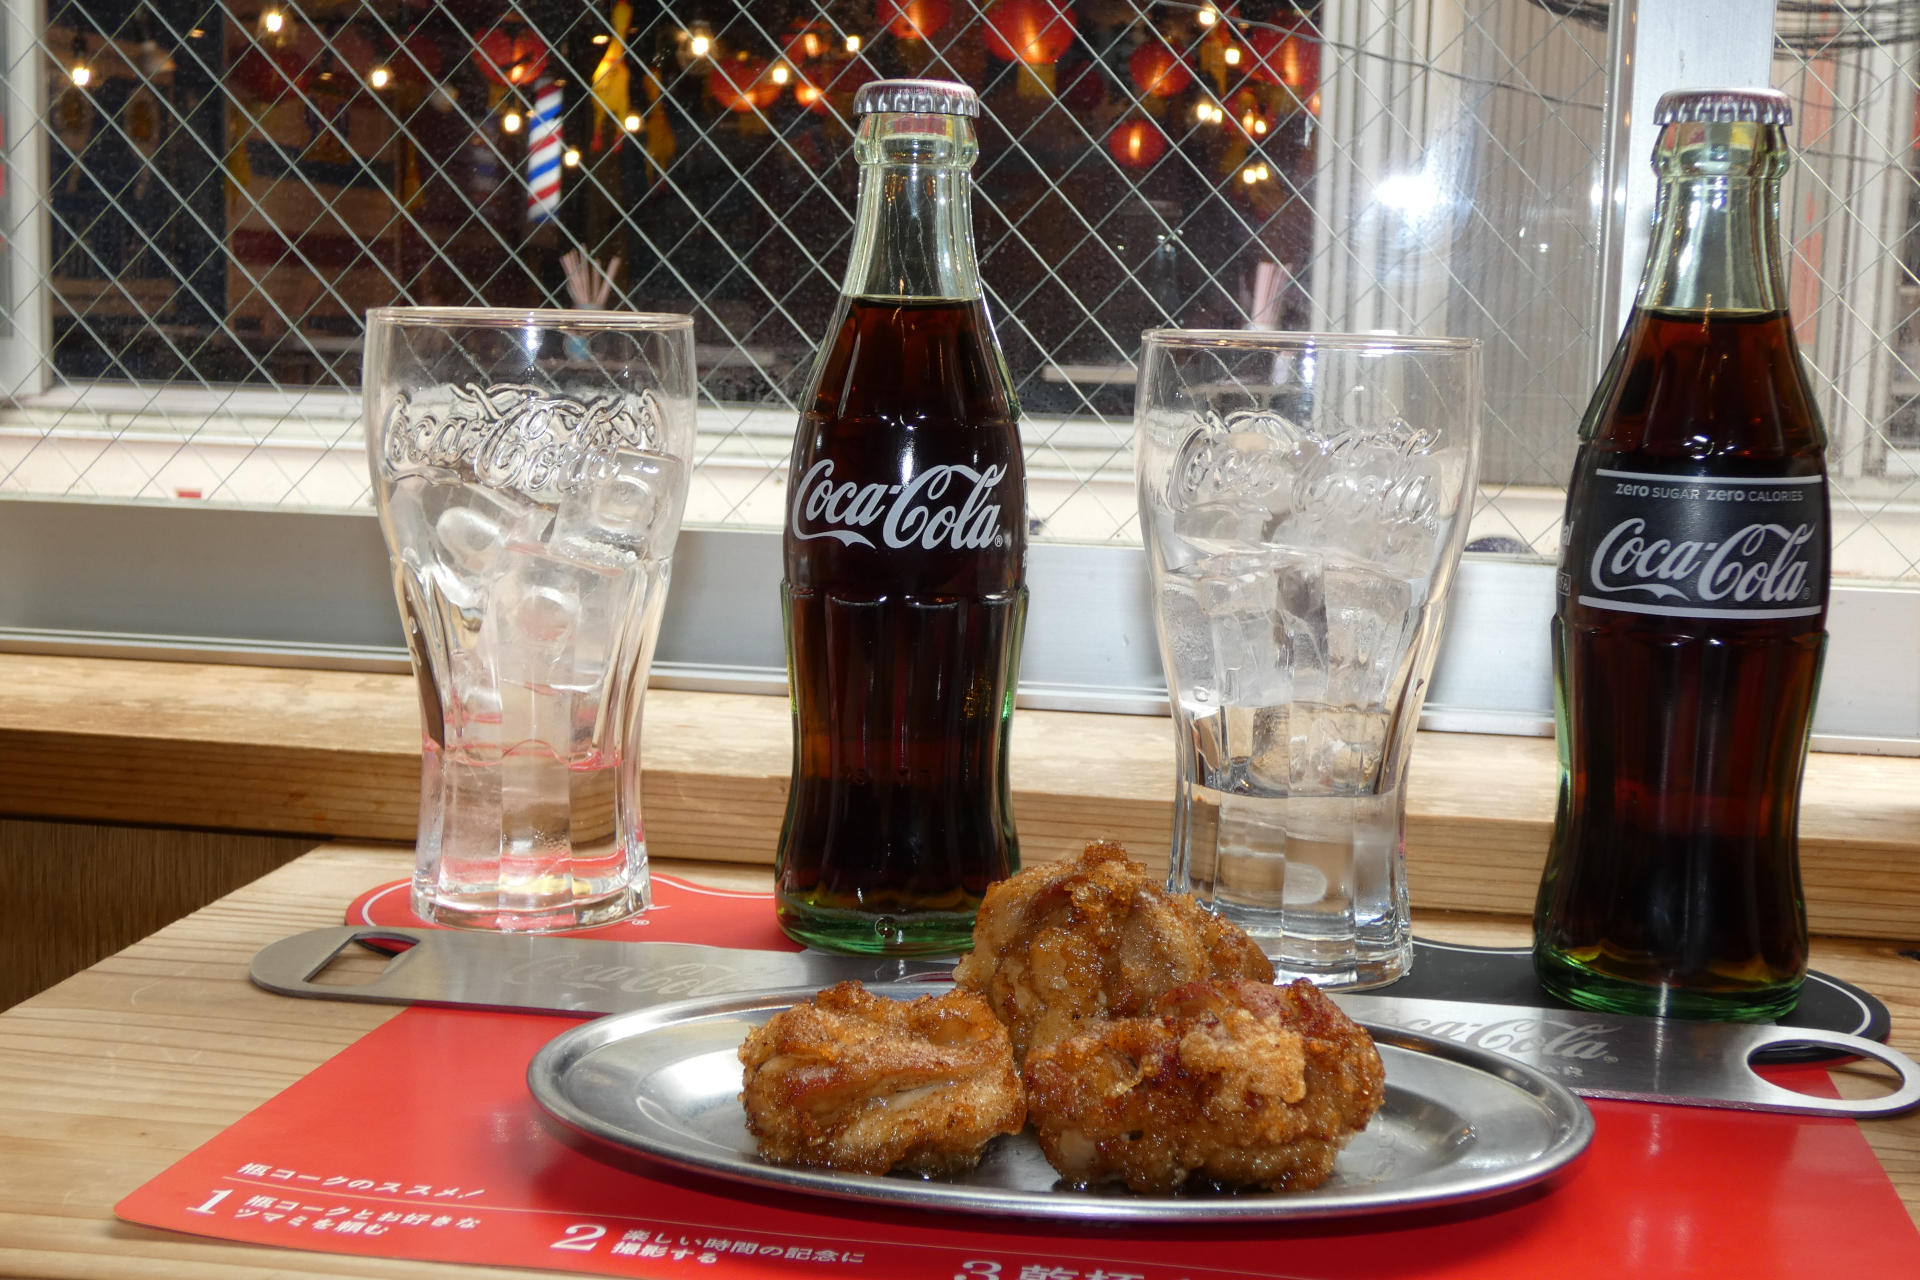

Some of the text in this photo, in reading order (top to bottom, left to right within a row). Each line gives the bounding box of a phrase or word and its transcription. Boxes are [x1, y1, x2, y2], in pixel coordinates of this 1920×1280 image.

[792, 459, 1008, 550] Coca-Cola
[1615, 482, 1803, 503] zero SUGAR zero CALORIES
[1590, 517, 1817, 603] Coca-Cola
[1362, 1007, 1623, 1061] ca-Cola
[186, 1188, 235, 1215] 1
[243, 1194, 482, 1230] 瓶コークとお好きな
[233, 1207, 391, 1237] ツマミを頼む
[549, 1223, 608, 1252] 2
[610, 1240, 720, 1265] 撮影する
[621, 1228, 866, 1264] 楽しい時間の記念に
